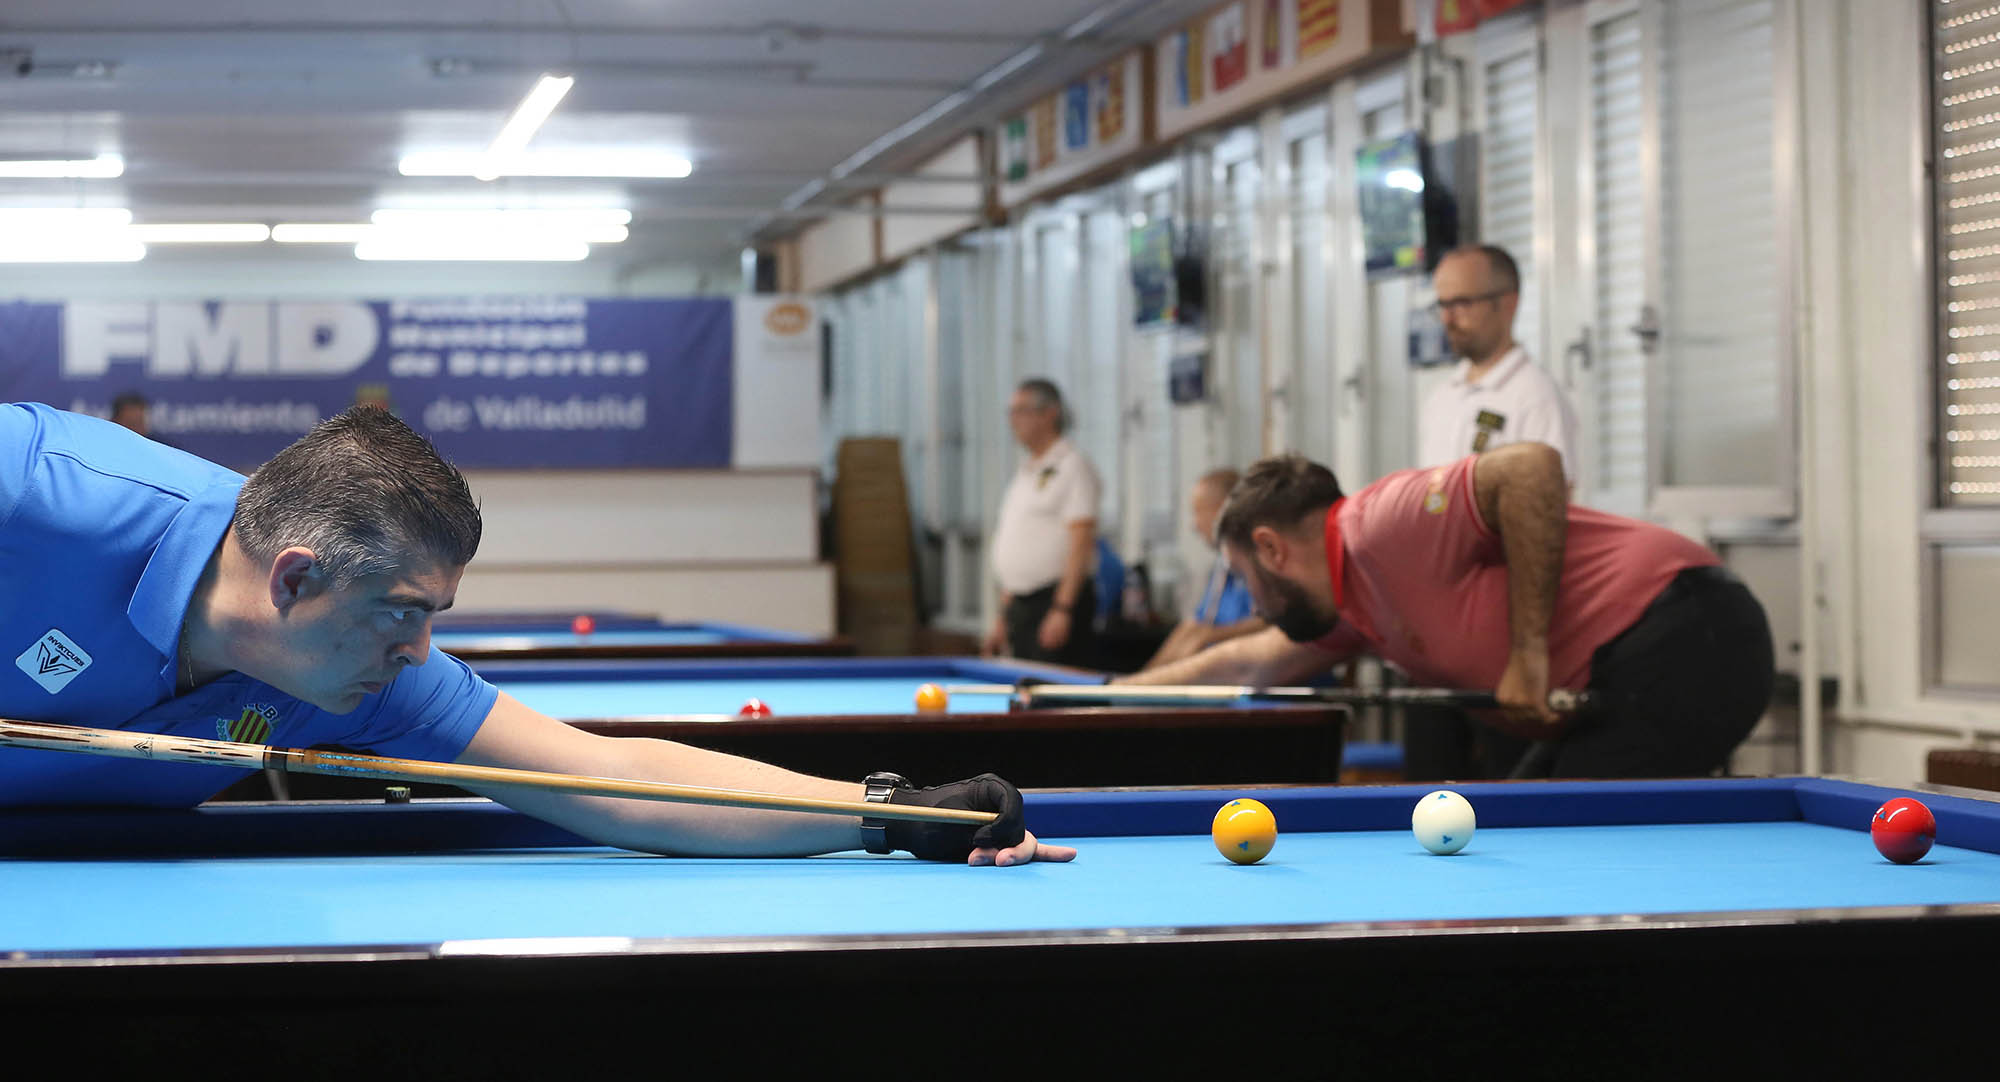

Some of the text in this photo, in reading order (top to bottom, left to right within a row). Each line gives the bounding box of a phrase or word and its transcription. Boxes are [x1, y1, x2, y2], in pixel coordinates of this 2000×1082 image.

[62, 298, 379, 377] FMD
[390, 352, 646, 379] de Deportes
[424, 398, 470, 431] de
[473, 396, 646, 429] Valladolid
